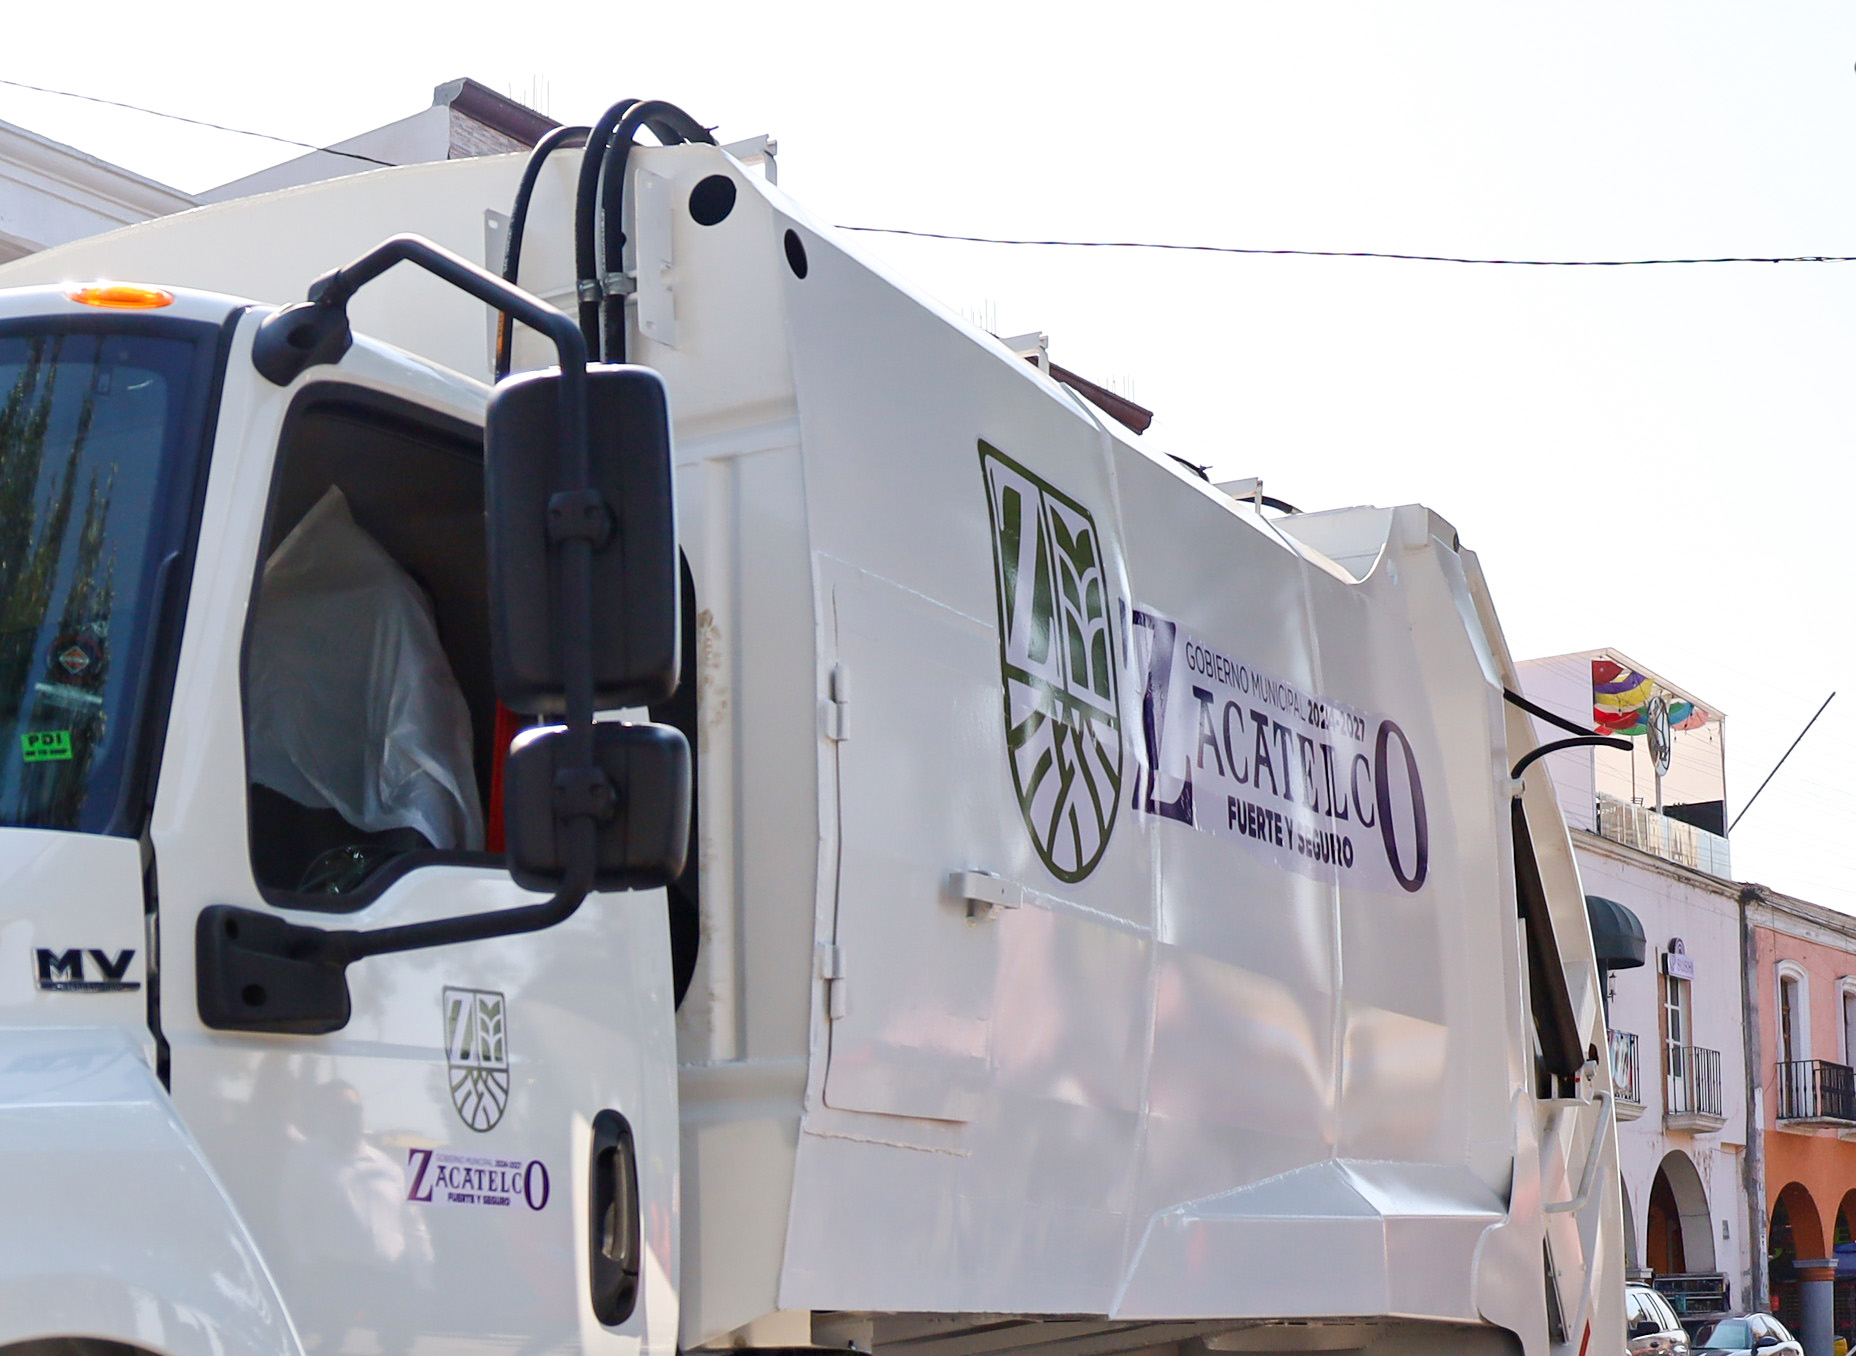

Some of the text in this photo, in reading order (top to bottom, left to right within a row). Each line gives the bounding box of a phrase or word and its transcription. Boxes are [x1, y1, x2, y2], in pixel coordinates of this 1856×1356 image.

[1185, 641, 1248, 693] GOBIERNO
[1251, 671, 1306, 721] MUNICIPAL
[28, 733, 62, 747] PDI
[1119, 597, 1428, 893] ZACATELCO
[1227, 795, 1353, 869] FUERTE Y SEGURO
[34, 948, 136, 982] MV
[407, 1148, 550, 1211] ZACATELCO
[447, 1192, 474, 1204] FUERTE
[483, 1195, 511, 1206] SEGURO
